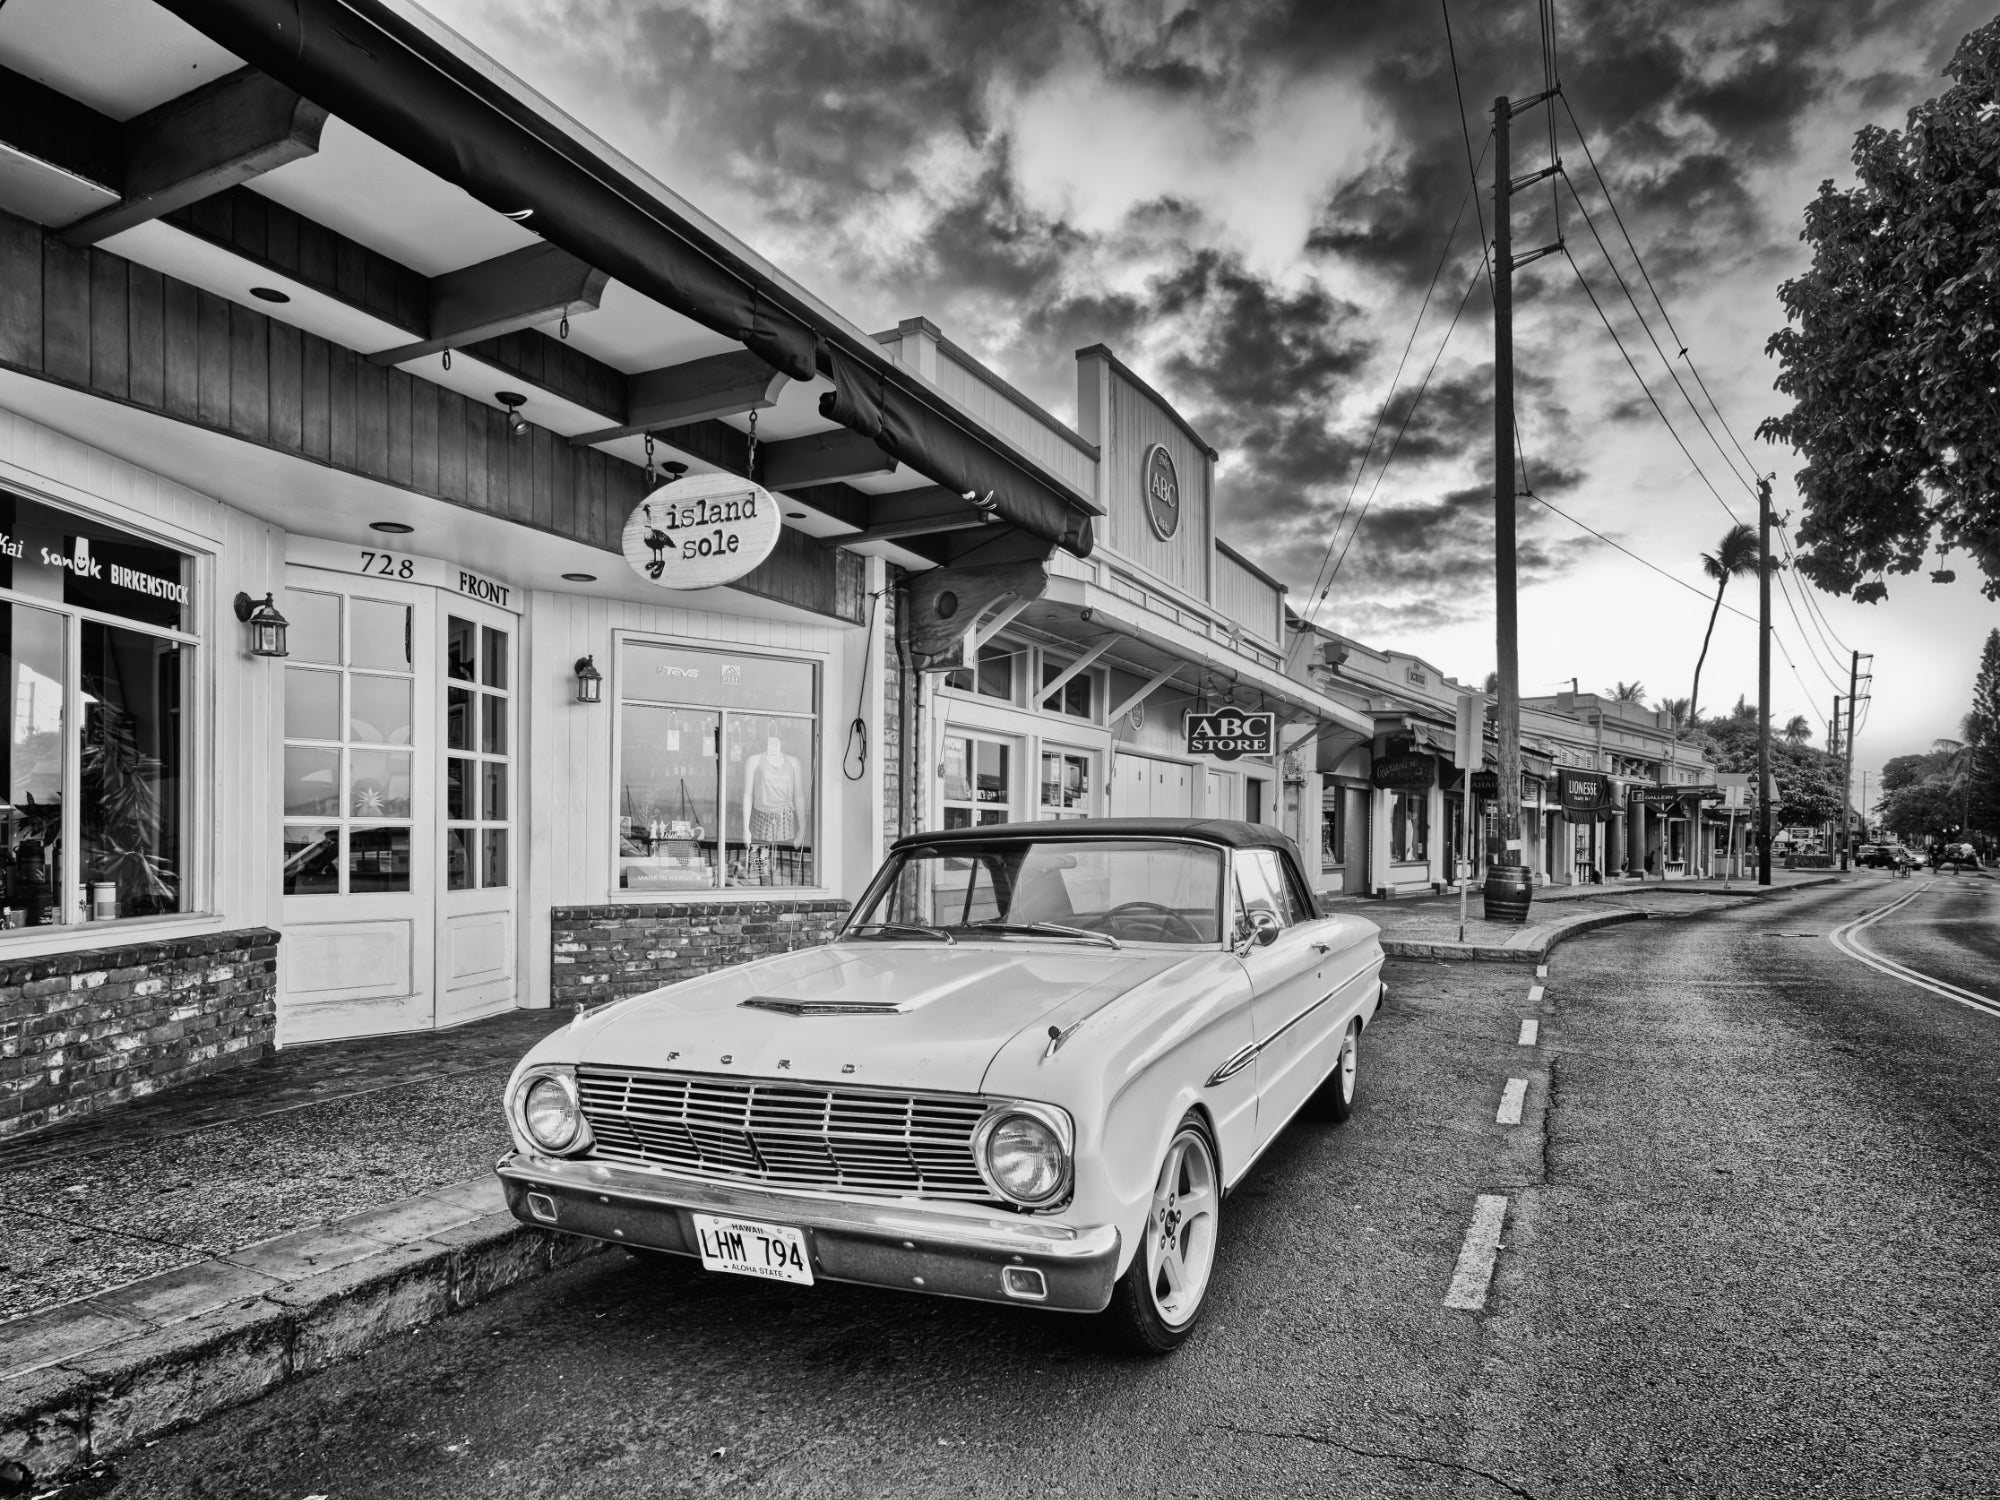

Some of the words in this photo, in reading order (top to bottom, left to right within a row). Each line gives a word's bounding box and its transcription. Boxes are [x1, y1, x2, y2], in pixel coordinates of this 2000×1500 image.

[1151, 471, 1176, 508] ABC
[666, 492, 758, 529] island
[682, 529, 739, 560] sole
[361, 551, 414, 579] 728
[110, 563, 189, 606] BIRKENSTOCK
[459, 571, 510, 607] FRONT
[1191, 717, 1267, 738] ABC
[1191, 739, 1267, 751] STORE
[1569, 780, 1597, 796] LIONESSE
[667, 1051, 856, 1074] FORD
[732, 1223, 764, 1235] HAWAII
[701, 1228, 747, 1262] LHM
[757, 1236, 803, 1272] 794
[732, 1263, 758, 1274] ALOHA
[759, 1267, 784, 1278] STATE
